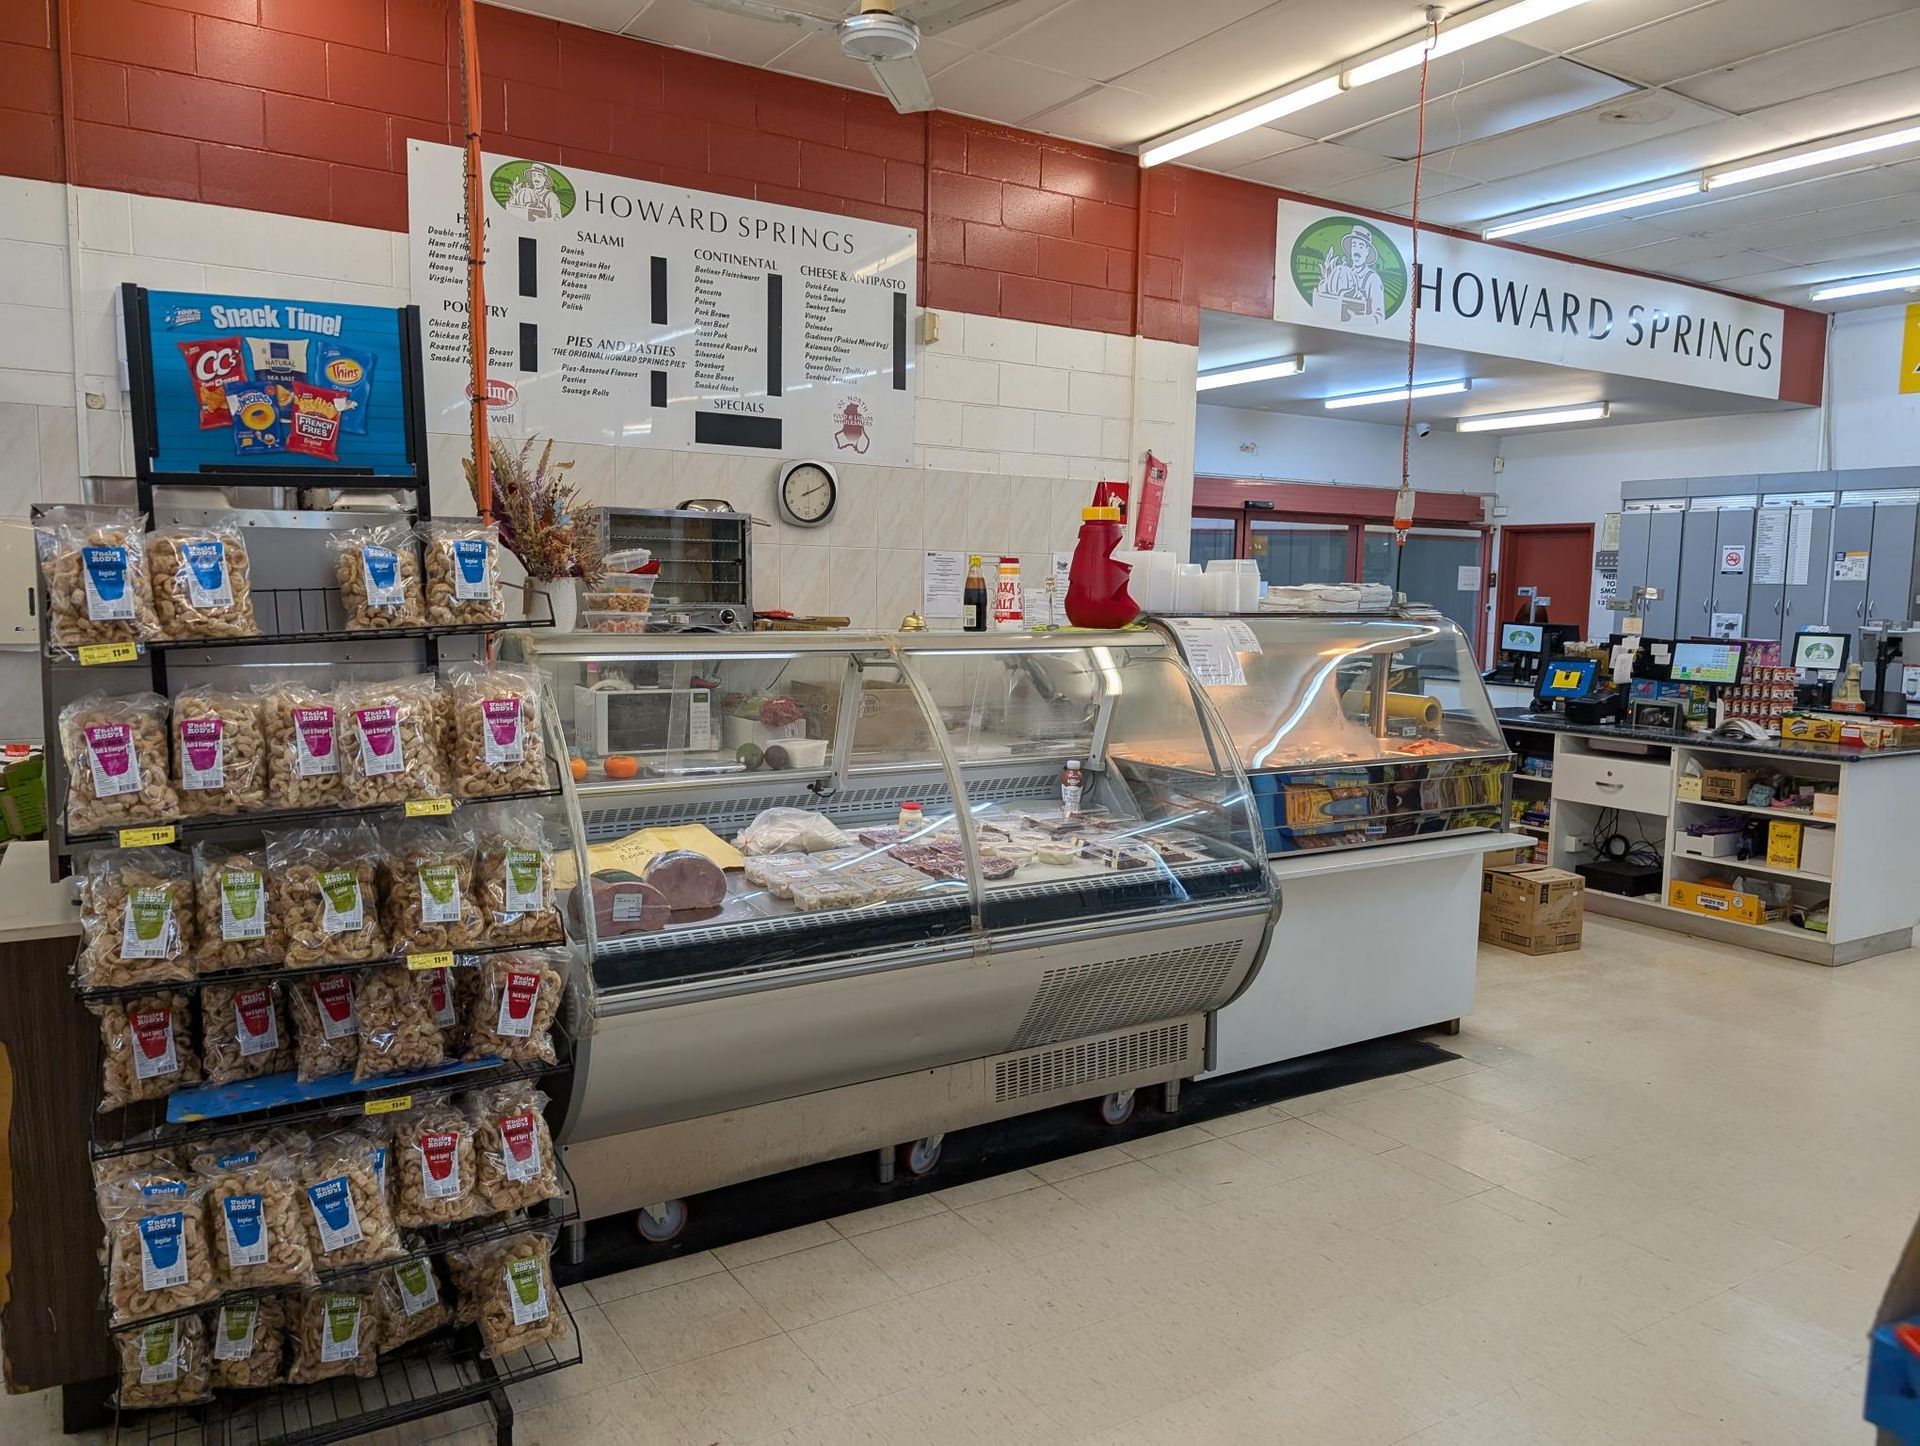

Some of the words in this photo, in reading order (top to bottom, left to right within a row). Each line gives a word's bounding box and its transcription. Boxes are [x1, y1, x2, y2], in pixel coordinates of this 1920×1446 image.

[586, 190, 728, 233] HOWARD
[738, 216, 854, 254] SPRINGS
[428, 238, 446, 247] Ham
[448, 241, 459, 249] off
[577, 230, 624, 248] SALAMI
[428, 250, 446, 259] Ham
[560, 245, 585, 256] Danish
[560, 256, 597, 268] Hungarian
[598, 262, 610, 270] Hot
[694, 248, 778, 270] CONTINENTAL
[429, 262, 454, 273] Honey
[695, 265, 721, 276] Berliner
[429, 274, 464, 284] Virginian
[561, 268, 597, 279] Hungarian
[598, 272, 615, 282] Mild
[800, 265, 839, 280] CHEESE
[840, 271, 848, 282] &
[849, 273, 906, 290] ANTIPASTO
[561, 279, 588, 290] Kabana
[823, 284, 840, 293] Edam
[695, 286, 722, 297] Pancetta
[823, 294, 846, 304] Smoked
[443, 300, 509, 318] POUTRY
[562, 301, 584, 311] Polish
[695, 307, 709, 316] Pork
[210, 305, 280, 329] Snack
[285, 306, 342, 337] Time!
[805, 312, 826, 322] Vintage
[1416, 262, 1613, 341] HOWARD
[1626, 303, 1773, 371] SPRINGS
[428, 318, 460, 329] Chicken
[713, 320, 730, 329] Beef
[429, 330, 460, 340] Chicken
[713, 330, 728, 339] Pork
[430, 342, 460, 352] Roasted
[489, 347, 514, 356] Breast
[566, 335, 593, 348] PIES
[597, 339, 626, 351] AND
[629, 342, 676, 357] PASTIES
[744, 345, 758, 354] Pork
[832, 345, 850, 354] Olives
[430, 353, 460, 363] Smoked
[488, 358, 513, 368] Breast
[568, 349, 604, 360] ORIGINAL
[604, 352, 637, 363] HOWARD
[638, 356, 669, 366] SPRINGS
[695, 350, 725, 360] Silverside
[265, 360, 296, 368] NATURAL
[695, 360, 725, 371] Strasburg
[805, 362, 824, 371] Queen
[824, 364, 842, 373] Olives
[328, 362, 359, 380] Thins
[561, 364, 610, 376] Pies-Assorted
[610, 368, 638, 378] Flavours
[695, 370, 715, 380] Bacon
[715, 372, 735, 382] Bones
[561, 375, 587, 384] Pasties
[561, 386, 590, 396] Sausage
[592, 388, 609, 397] Rolls
[695, 381, 719, 391] Smoked
[720, 383, 739, 392] Hocks
[714, 398, 765, 414] SPECIALS
[299, 416, 332, 430] FRENCH
[491, 414, 514, 424] well
[302, 425, 328, 437] FRIES
